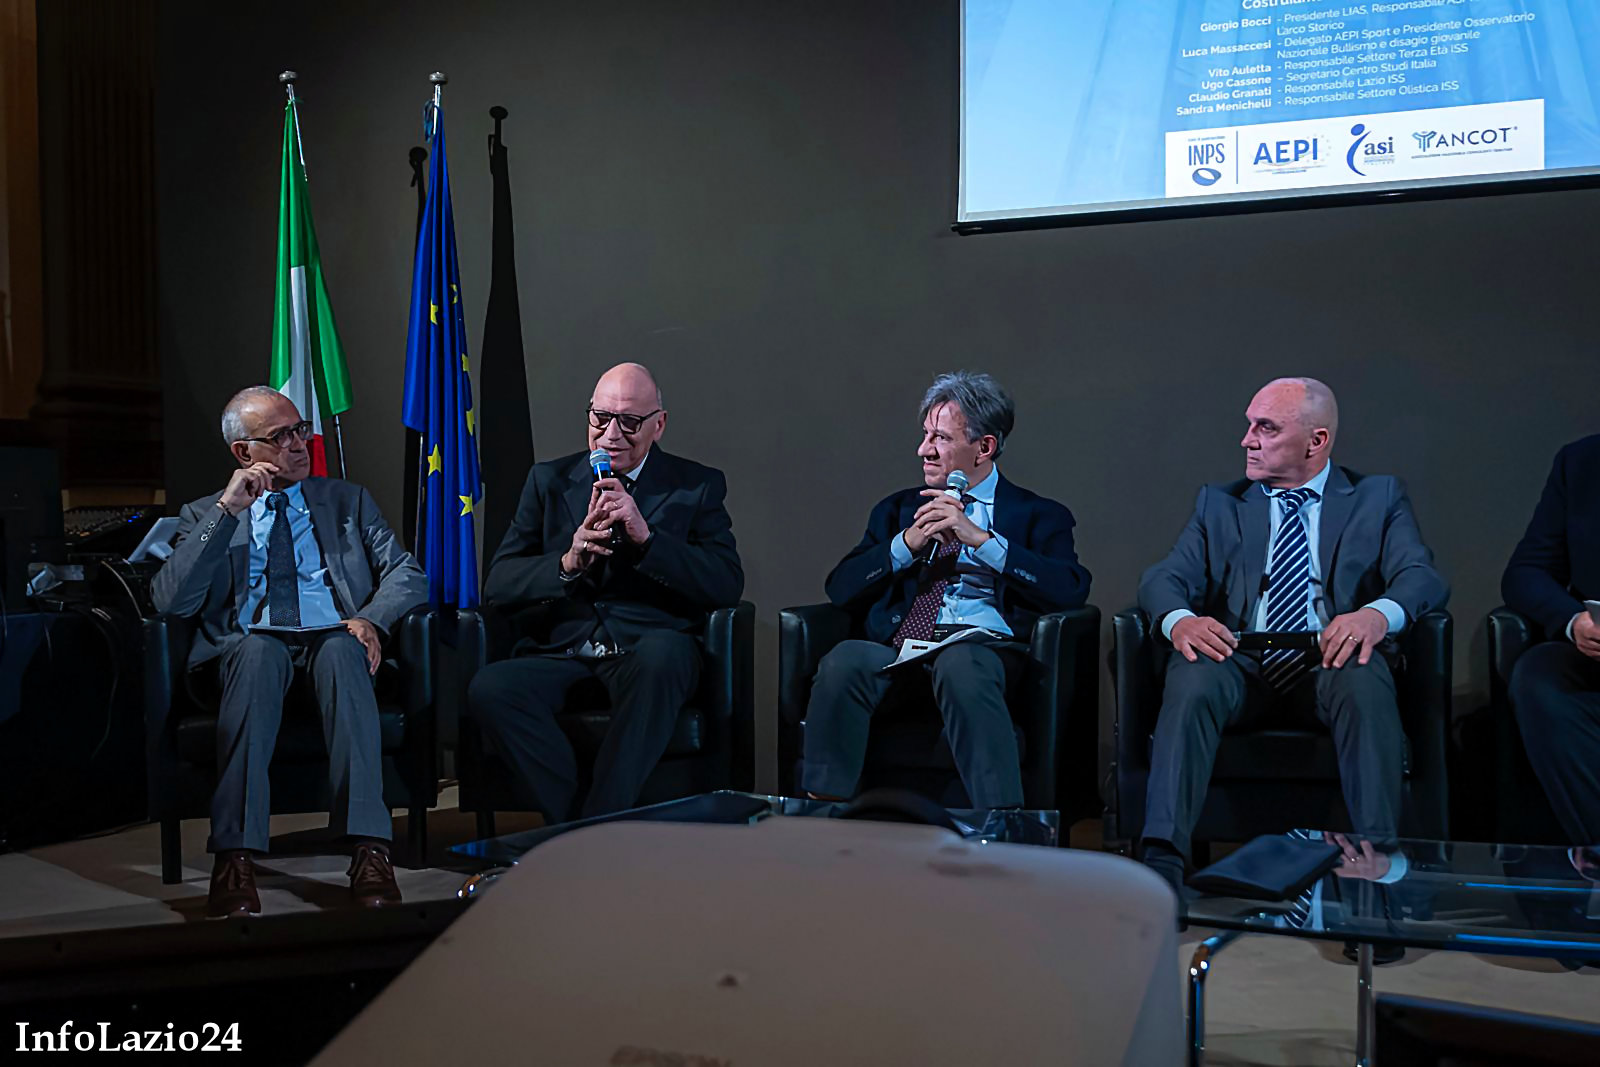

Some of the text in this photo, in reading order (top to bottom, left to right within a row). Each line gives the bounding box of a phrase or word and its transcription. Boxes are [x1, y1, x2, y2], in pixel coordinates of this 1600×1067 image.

[1200, 21, 1238, 32] Giorgio
[1241, 16, 1271, 27] Bocci
[1284, 10, 1340, 22] Presidente
[1371, 0, 1445, 13] Responsabile
[1242, 0, 1322, 9] Costru
[1182, 48, 1208, 58] Luca
[1210, 40, 1272, 54] Massaccesi
[1284, 34, 1332, 48] Delegato
[1334, 30, 1359, 40] AEPI
[1361, 28, 1391, 40] Sport
[1402, 20, 1462, 34] Presidente
[1464, 12, 1536, 28] Osservatorio
[1308, 20, 1345, 32] Storico
[1277, 46, 1328, 59] Nazionale
[1331, 42, 1377, 54] Bullismo
[1389, 35, 1428, 48] disagio
[1430, 30, 1480, 44] giovanile
[1208, 68, 1230, 78] Vito
[1232, 64, 1272, 76] Auletta
[1284, 56, 1354, 70] Responsabile
[1357, 52, 1396, 62] Settore
[1398, 49, 1428, 59] Terza
[1450, 43, 1468, 53] ISS
[1189, 90, 1230, 102] Claudio
[1232, 87, 1272, 99] Granati
[1284, 79, 1354, 94] Responsabile
[1357, 77, 1386, 86] Lazio
[1388, 74, 1406, 84] ISS
[1202, 80, 1224, 92] Ugo
[1226, 76, 1272, 88] Cassone
[1286, 68, 1340, 83] Segretario
[1342, 66, 1378, 76] Centro
[1380, 60, 1408, 72] Studi
[1411, 58, 1436, 69] Italia
[1176, 104, 1214, 116] Sandra
[1216, 98, 1272, 112] Menichelli
[1284, 92, 1354, 106] Responsabile
[1357, 88, 1396, 99] Settore
[1398, 84, 1438, 96] Olistica
[1441, 81, 1460, 92] ISS
[1364, 136, 1394, 156] asi
[1436, 127, 1512, 148] ANCOT
[1188, 143, 1225, 166] INPS
[1253, 138, 1318, 166] AEPI
